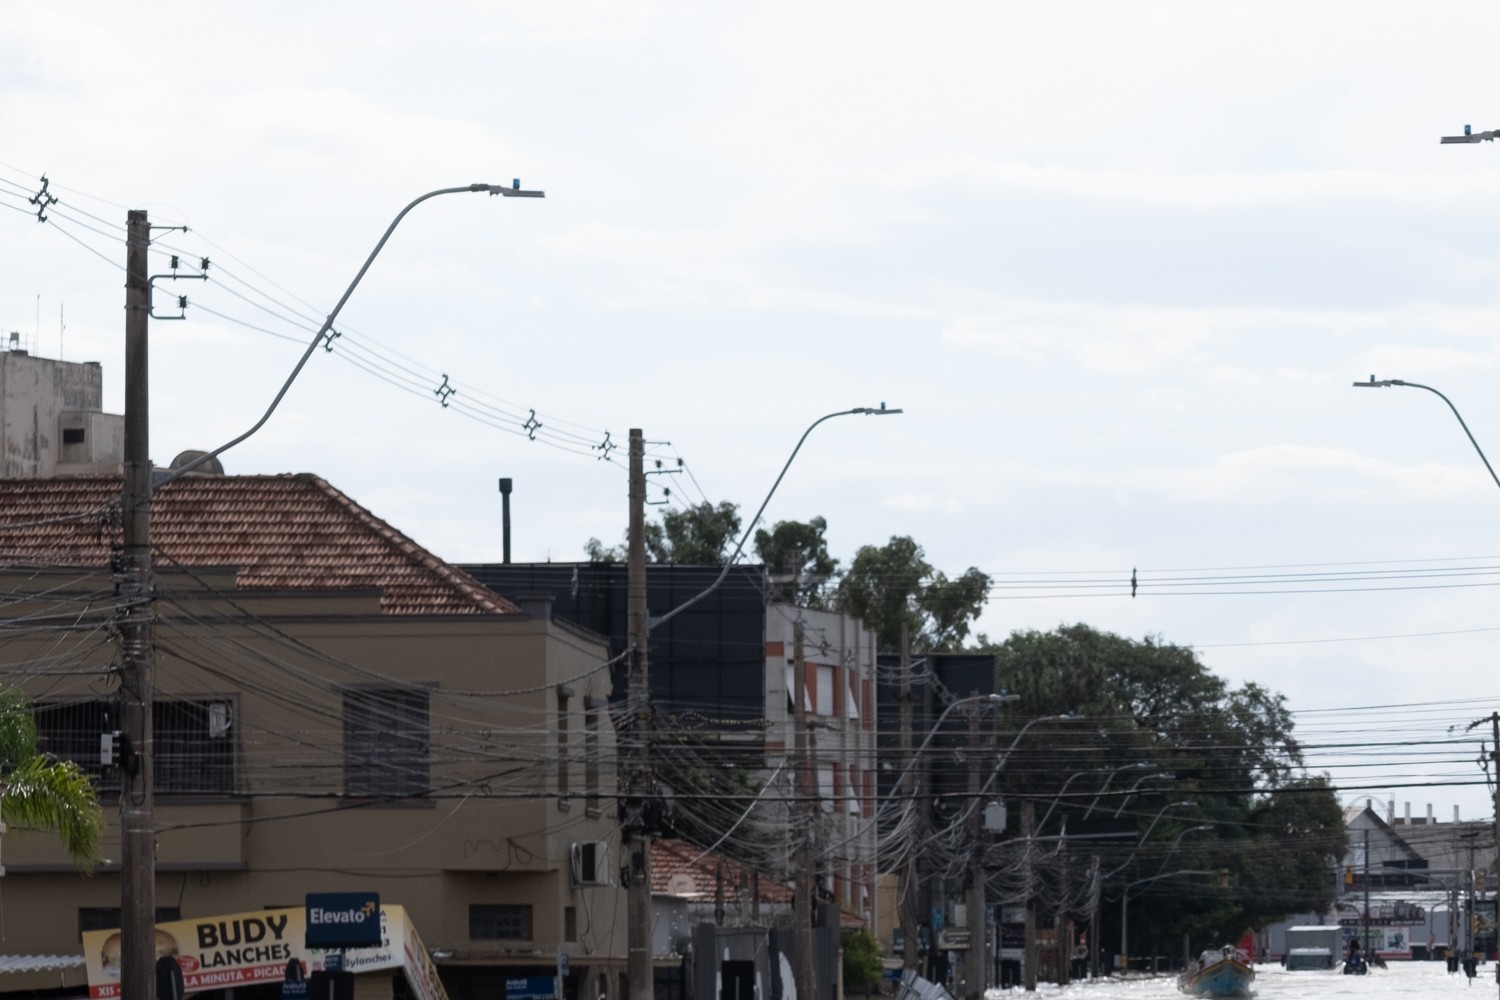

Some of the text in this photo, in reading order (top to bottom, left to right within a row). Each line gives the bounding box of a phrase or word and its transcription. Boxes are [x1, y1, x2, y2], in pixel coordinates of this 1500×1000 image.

[310, 907, 365, 924] Elevato
[197, 914, 288, 949] BUDY
[200, 944, 291, 969] LANCHES
[98, 985, 115, 997] XIS
[201, 971, 244, 985] MINUTA
